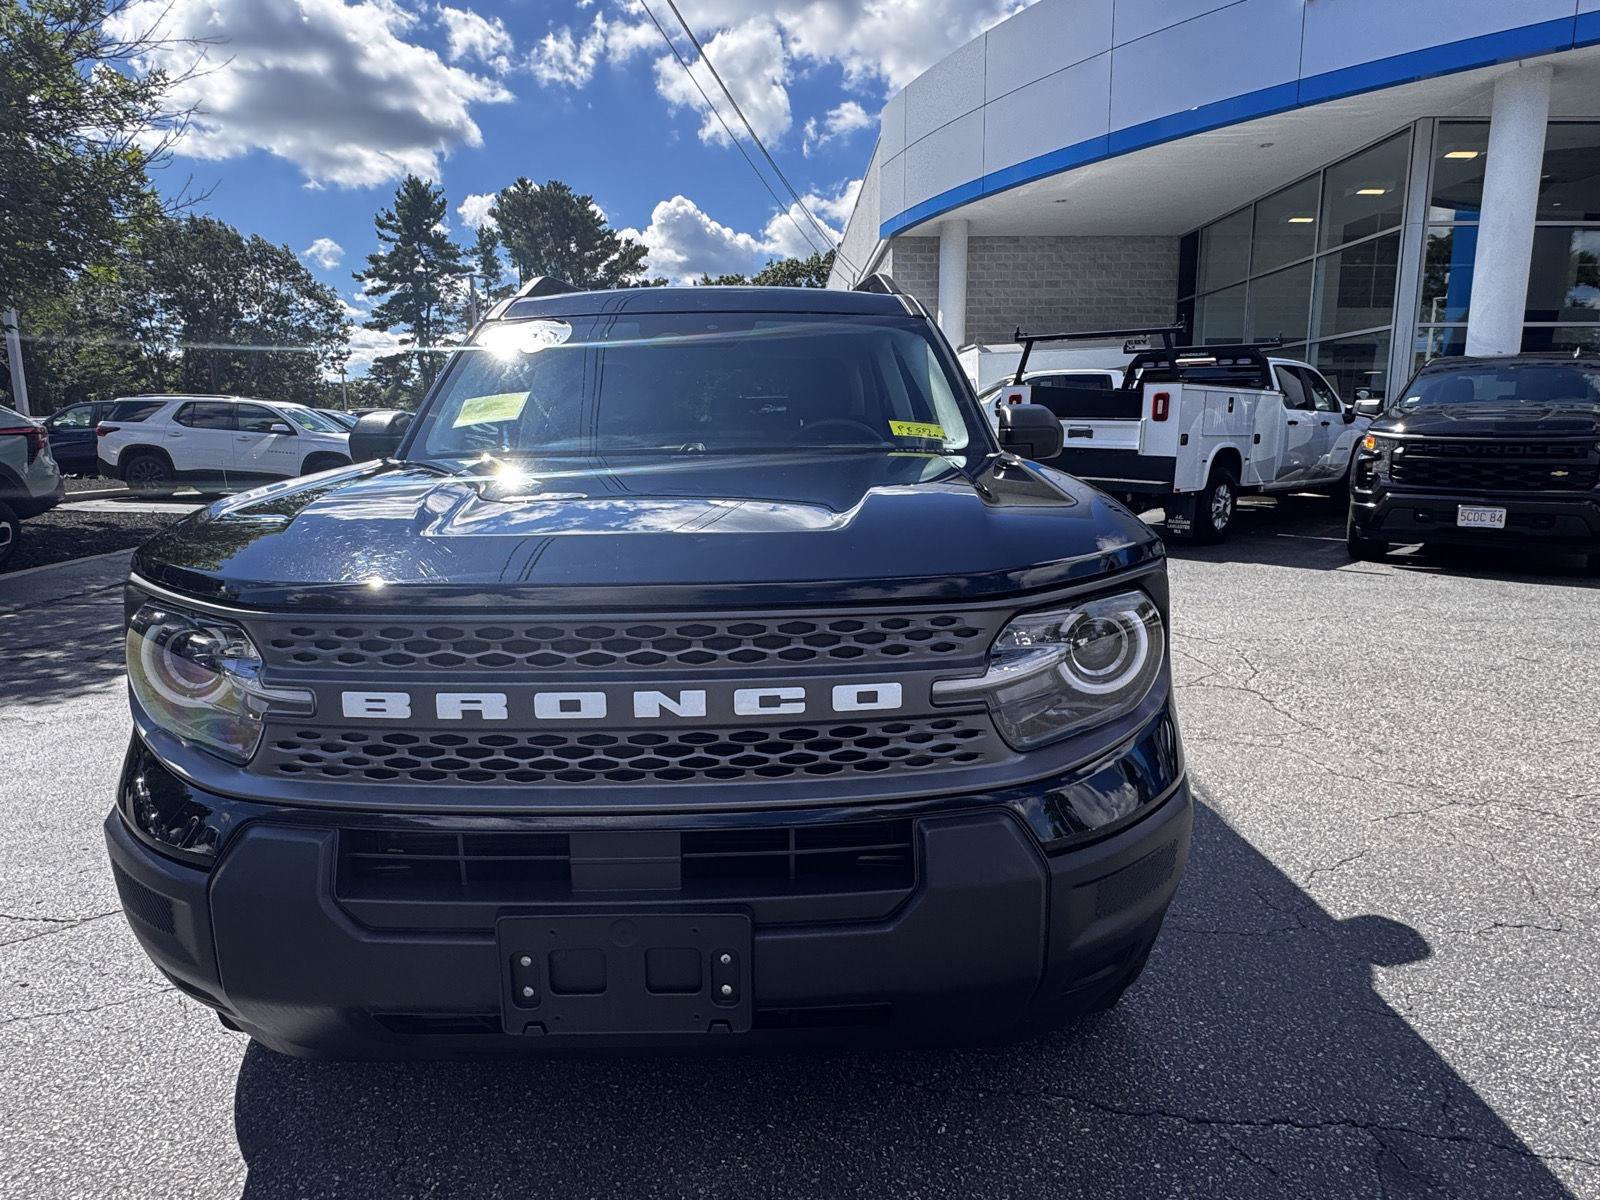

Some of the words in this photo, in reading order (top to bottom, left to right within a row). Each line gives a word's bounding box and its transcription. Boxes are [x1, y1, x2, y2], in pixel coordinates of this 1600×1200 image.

[1407, 443, 1584, 454] CHEVROLET
[1460, 511, 1487, 522] 5CDC
[1490, 512, 1503, 523] 84
[341, 682, 902, 720] BRONCO
